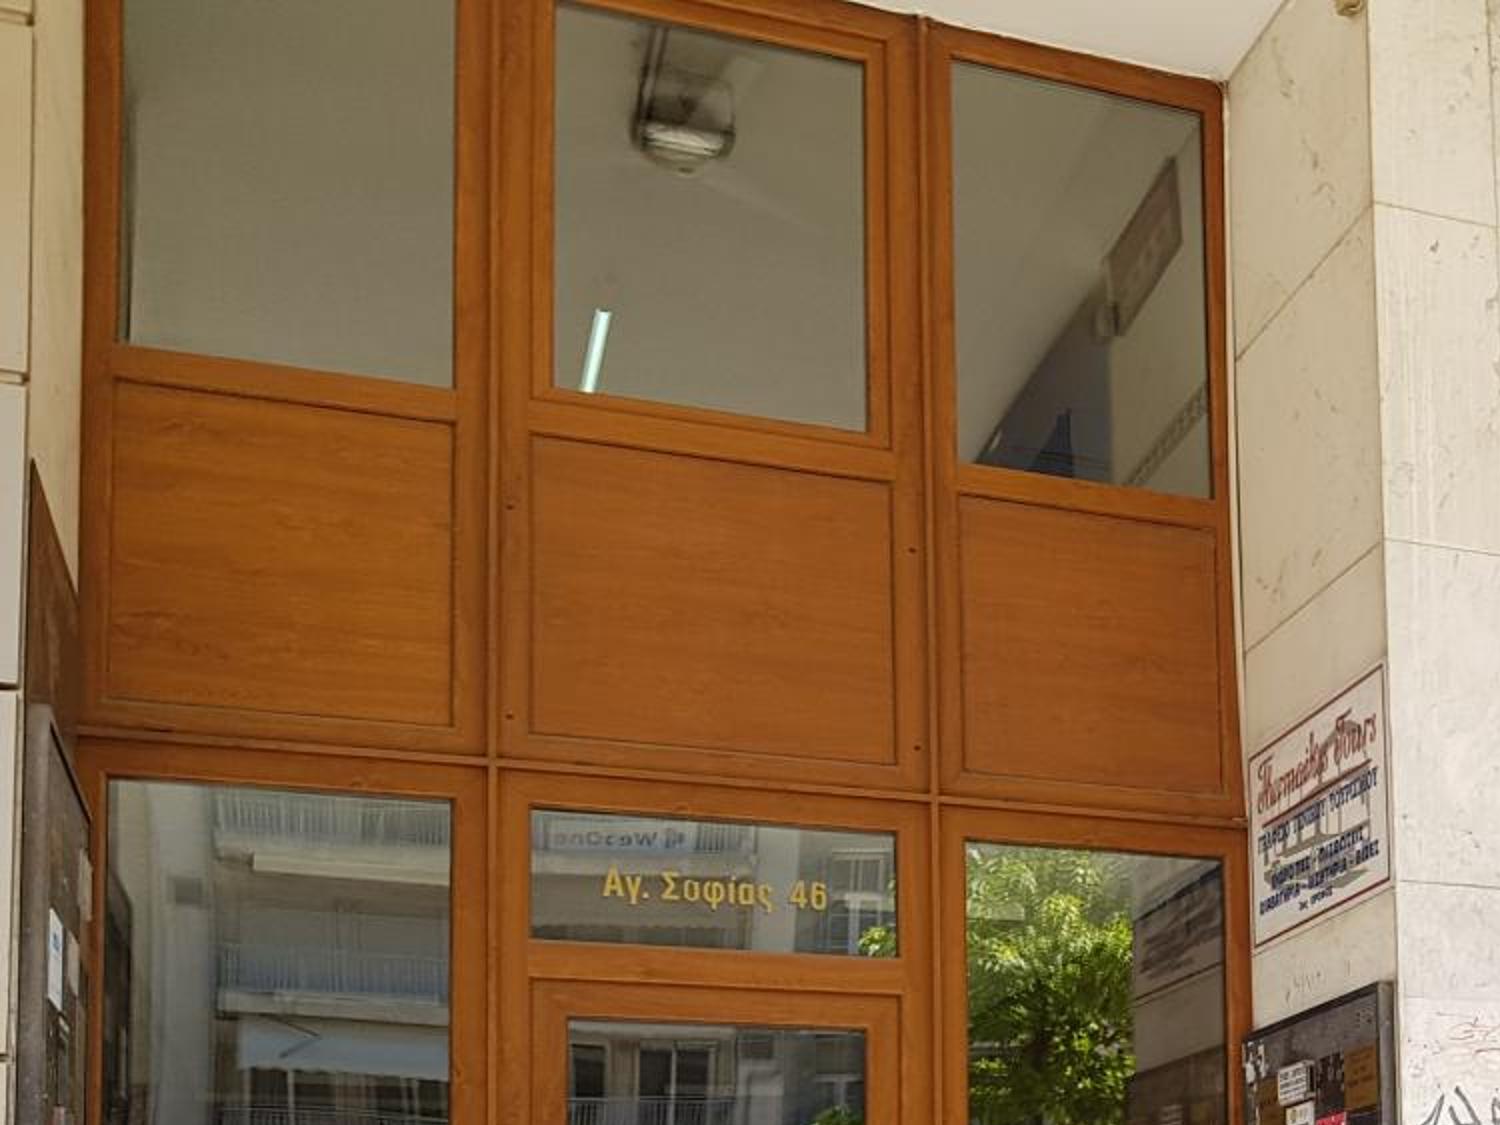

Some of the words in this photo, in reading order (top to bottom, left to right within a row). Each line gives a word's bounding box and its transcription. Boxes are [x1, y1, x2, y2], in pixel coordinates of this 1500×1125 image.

[1333, 707, 1377, 767] Tours
[603, 864, 649, 904] Αγ.
[789, 880, 827, 912] 46
